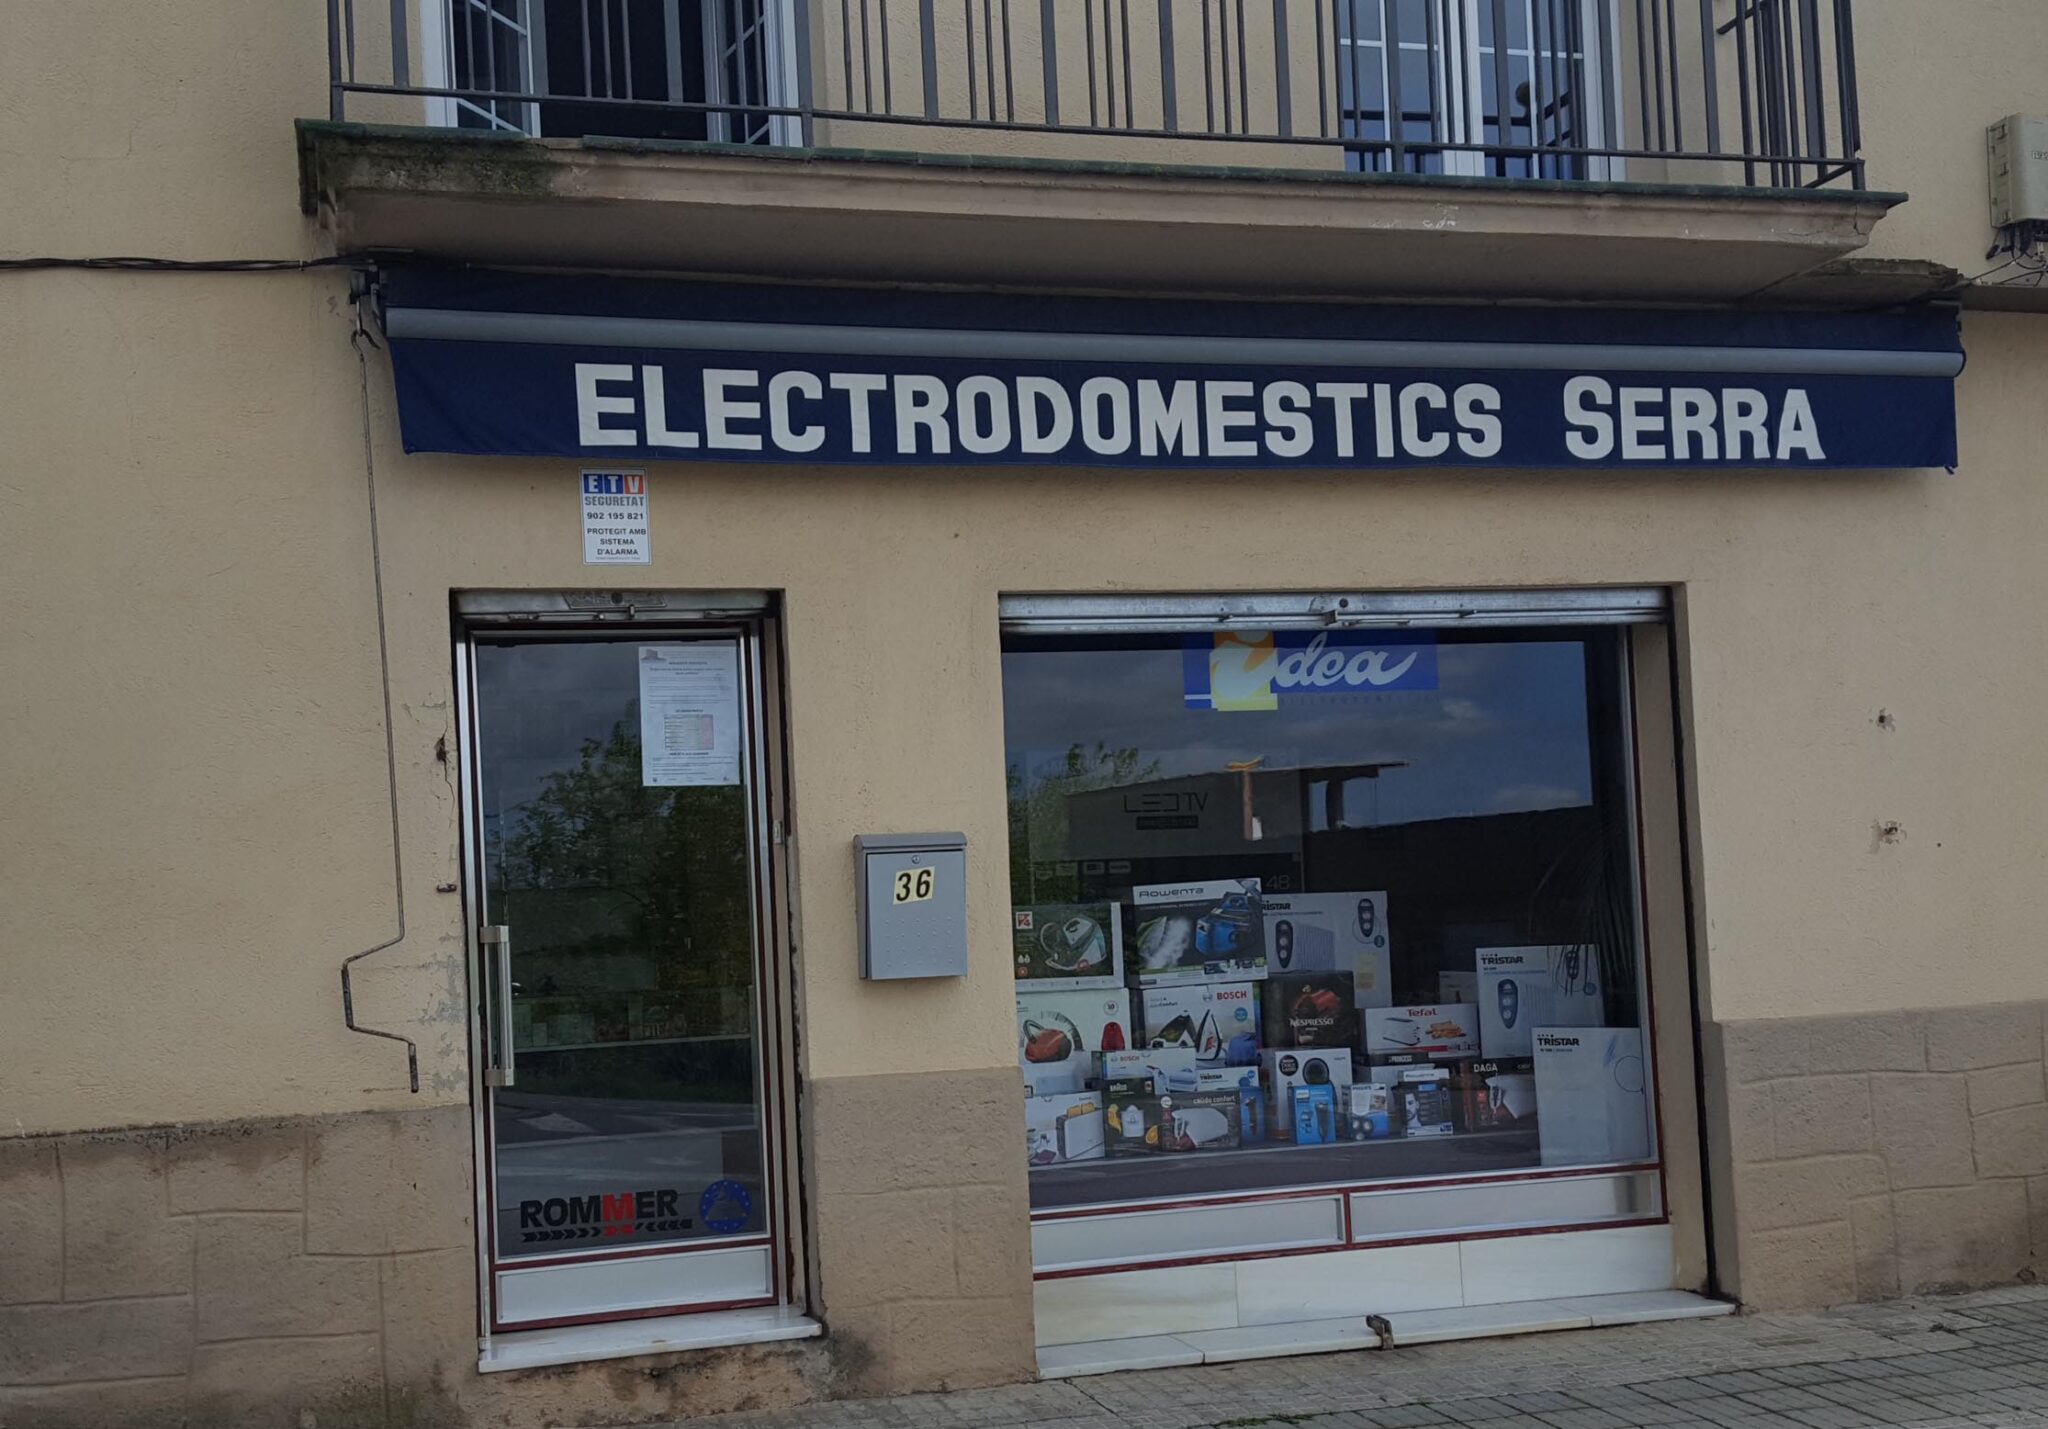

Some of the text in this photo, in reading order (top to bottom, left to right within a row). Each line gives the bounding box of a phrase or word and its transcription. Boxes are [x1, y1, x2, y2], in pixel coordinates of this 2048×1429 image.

[574, 362, 1827, 460] ELECTRODOMESTICS SERRA
[585, 474, 642, 494] ETV
[584, 496, 645, 506] SEGURETAT
[586, 512, 644, 520] 902 195 821
[586, 527, 627, 535] PROTEGIT
[596, 548, 639, 556] D'ALARMA
[895, 868, 932, 902] 36
[1216, 990, 1248, 1000] BOSCH
[1407, 1007, 1439, 1017] Tefal
[1473, 1062, 1499, 1073] DAGA
[520, 1189, 679, 1229] ROMMER
